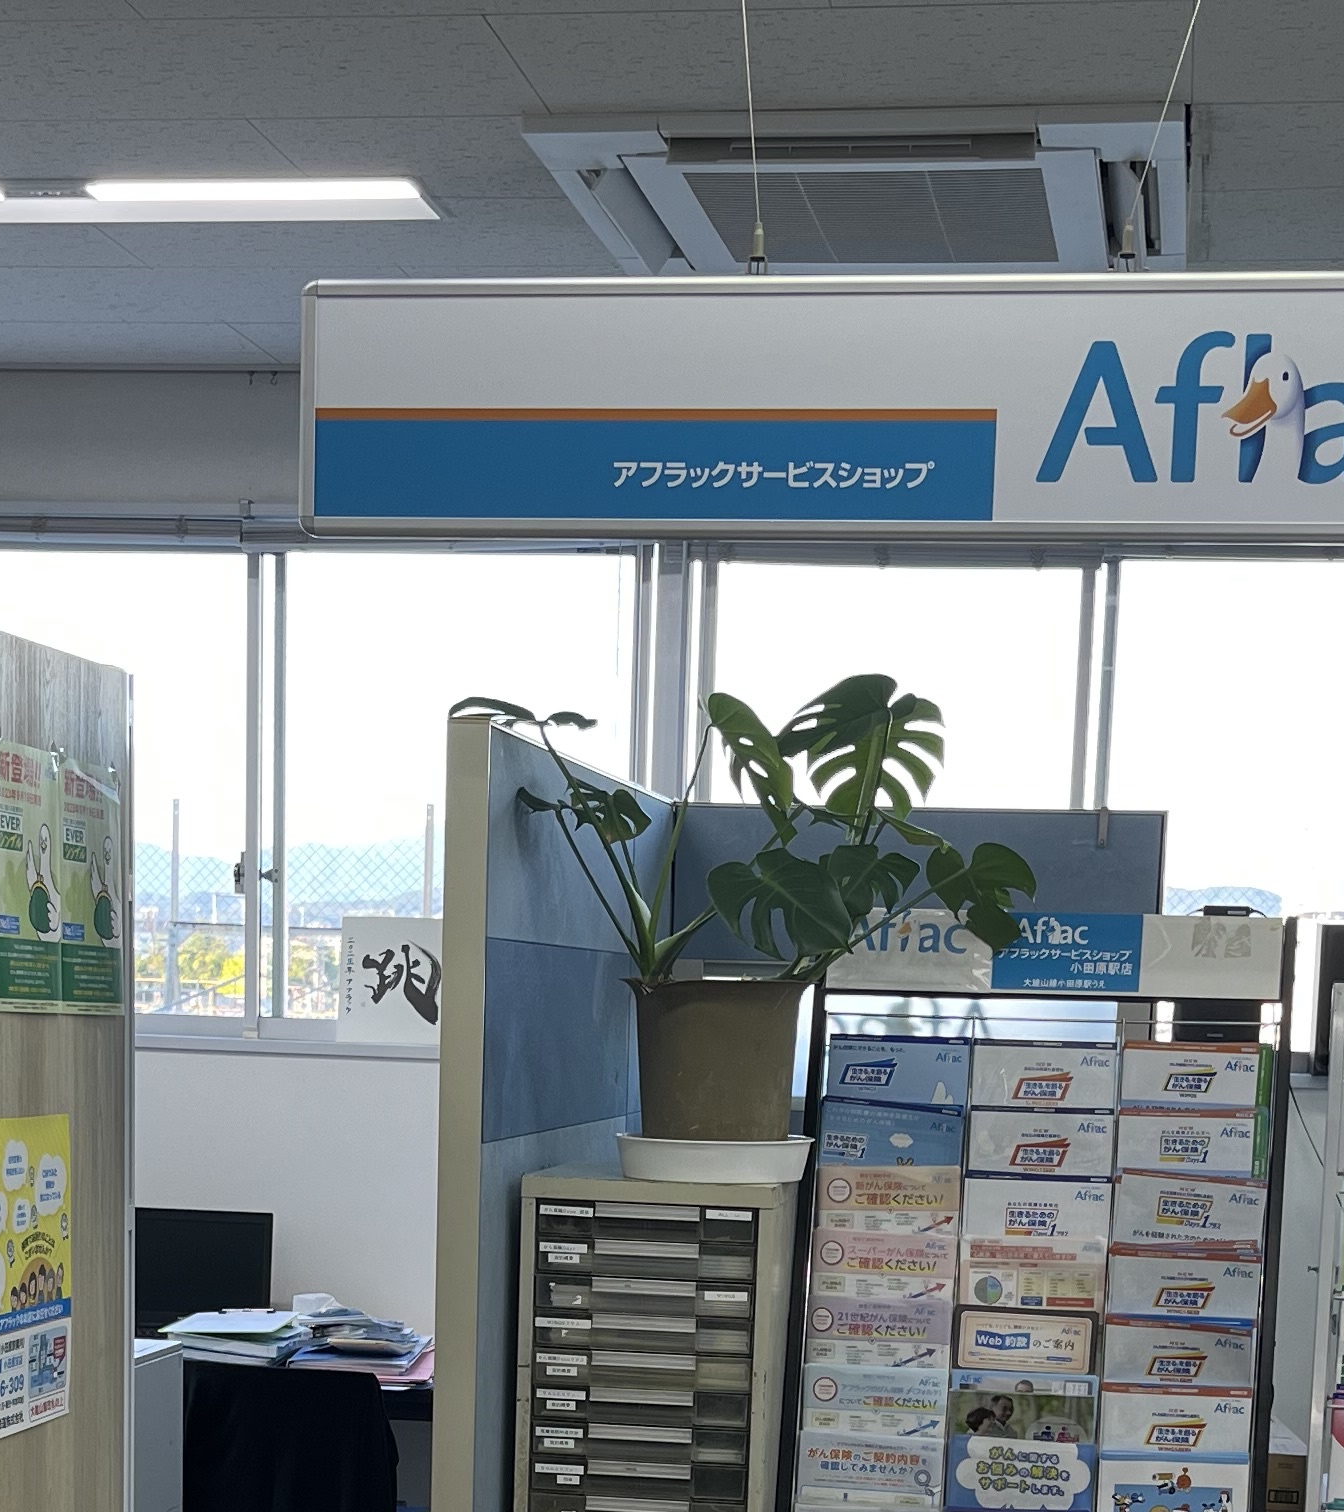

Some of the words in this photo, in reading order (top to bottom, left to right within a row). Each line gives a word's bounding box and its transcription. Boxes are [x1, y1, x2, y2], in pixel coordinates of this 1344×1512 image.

[613, 461, 935, 488] アフラックサービスショップ
[0, 814, 21, 832] EVER
[65, 827, 85, 844] EVER
[1012, 917, 1088, 945] Aflac
[998, 948, 1132, 961] アフラックサービスショップ
[1070, 962, 1132, 976] 小田原駅店
[935, 1052, 962, 1063] Aflac
[1080, 1056, 1109, 1067] Aflac
[1224, 1061, 1255, 1072] Aflac
[849, 1075, 882, 1083] がん保険
[1077, 1122, 1107, 1134] Aflac
[1220, 1127, 1250, 1139] Aflac
[826, 1134, 864, 1143] 生きるための
[826, 1142, 857, 1150] がん保険
[1075, 1190, 1104, 1201] Aflac
[1229, 1193, 1259, 1206] Aflac
[1162, 1200, 1207, 1210] 生きるための
[1008, 1211, 1055, 1219] 生きるための
[1161, 1208, 1200, 1217] がん保険
[1008, 1219, 1047, 1227] がん保険
[848, 1246, 948, 1259] スーパーがん保険について
[1223, 1267, 1253, 1278] Aflac
[837, 1312, 931, 1324] 21世紀がん保険について
[1033, 1336, 1075, 1351] のご案内
[1215, 1338, 1245, 1350] Aflac
[1214, 1403, 1244, 1414] Aflac
[807, 1448, 928, 1466] がん保険のご契約内容を
[989, 1446, 1060, 1464] がんに関する
[976, 1461, 1070, 1481] お悩みの解決を
[979, 1477, 1065, 1496] サポートします。
